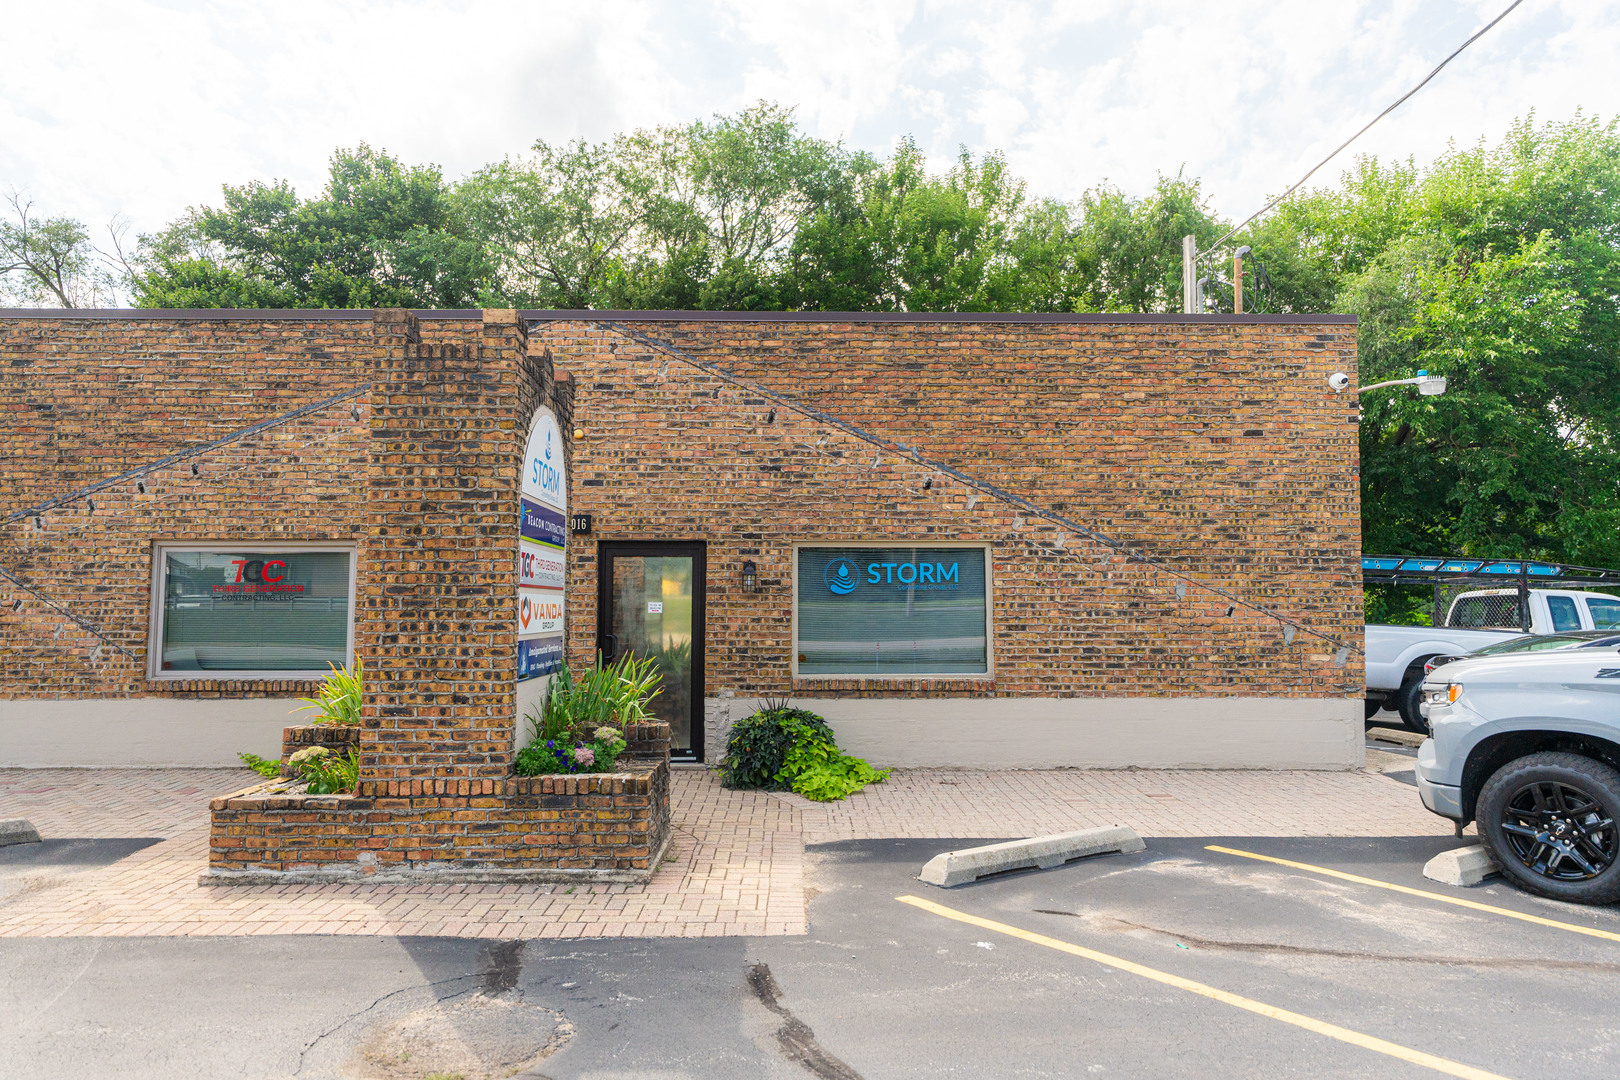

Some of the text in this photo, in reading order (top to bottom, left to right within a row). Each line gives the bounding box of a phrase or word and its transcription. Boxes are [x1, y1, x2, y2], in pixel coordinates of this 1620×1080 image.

[533, 457, 560, 496] STORM
[527, 514, 545, 529] BEACON
[521, 551, 535, 579] TGC
[867, 562, 959, 584] STORM
[212, 584, 304, 593] THIRD GENERATION
[533, 603, 562, 620] VANDA
